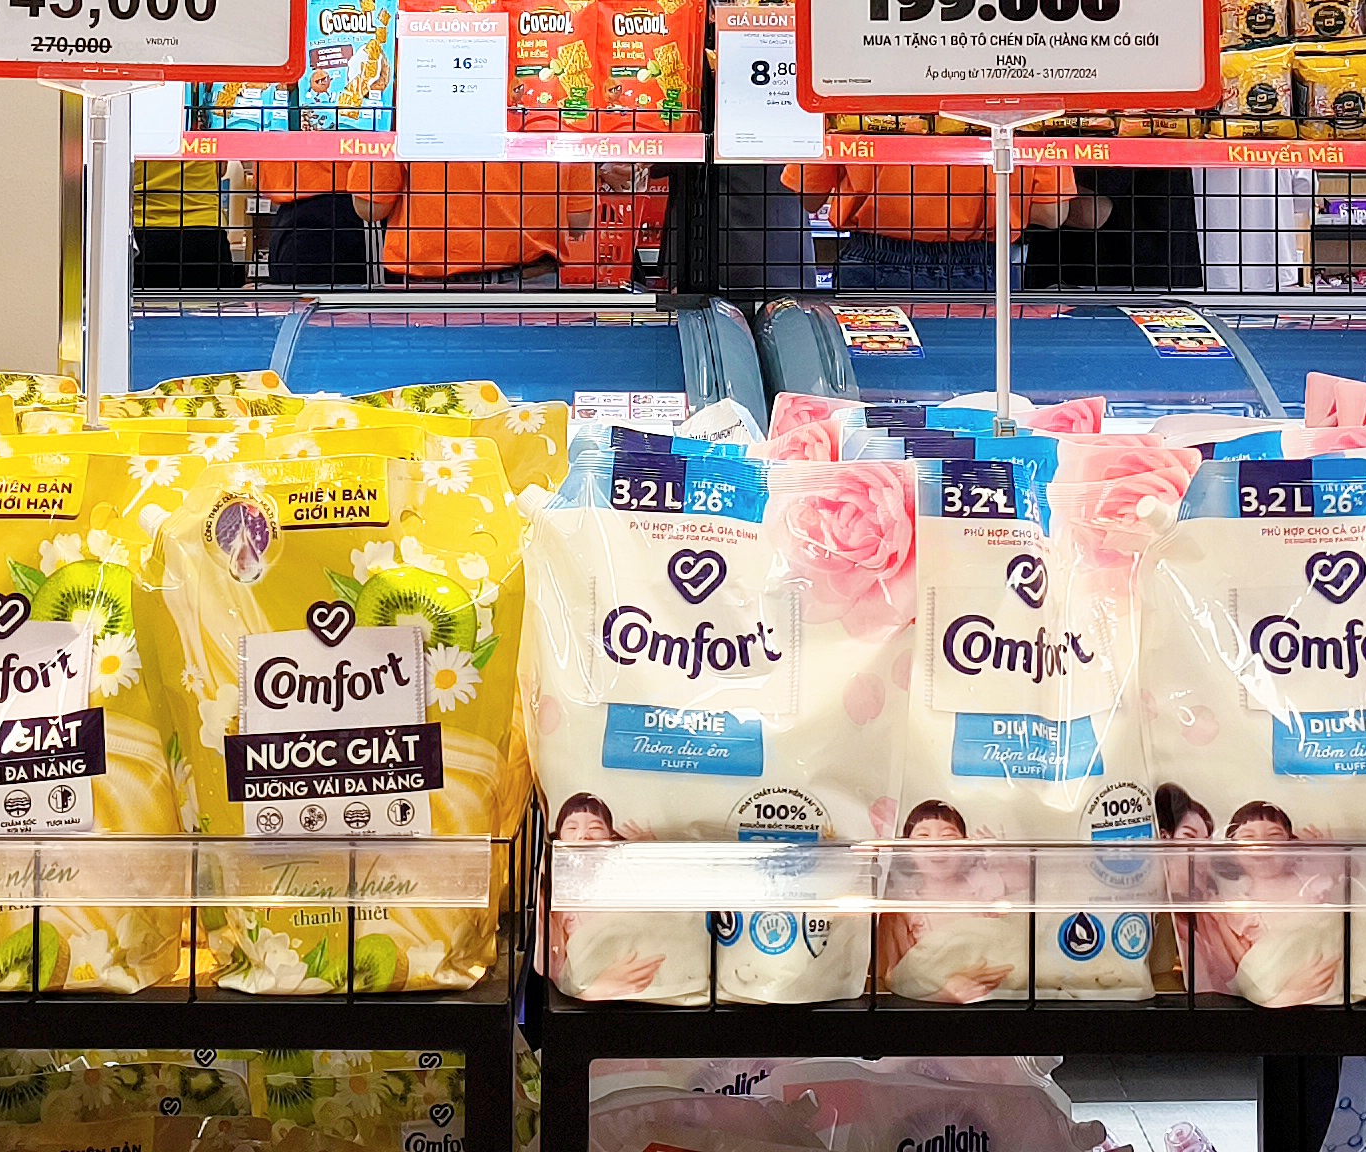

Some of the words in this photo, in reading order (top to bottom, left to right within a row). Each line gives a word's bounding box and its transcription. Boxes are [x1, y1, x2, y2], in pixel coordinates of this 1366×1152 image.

[409, 19, 432, 33] GIÁ
[434, 19, 470, 33] LUÔN
[31, 36, 112, 54] 270,000
[1228, 144, 1302, 165] Khuyến
[1310, 144, 1344, 163] Mãi
[602, 605, 782, 680] Comfort
[254, 652, 411, 713] Comfort
[246, 735, 337, 772] NƯỚC
[346, 729, 420, 768] GIẶT
[245, 775, 308, 799] DƯỠNG
[343, 775, 368, 794] ĐA
[372, 769, 425, 792] NĂNG
